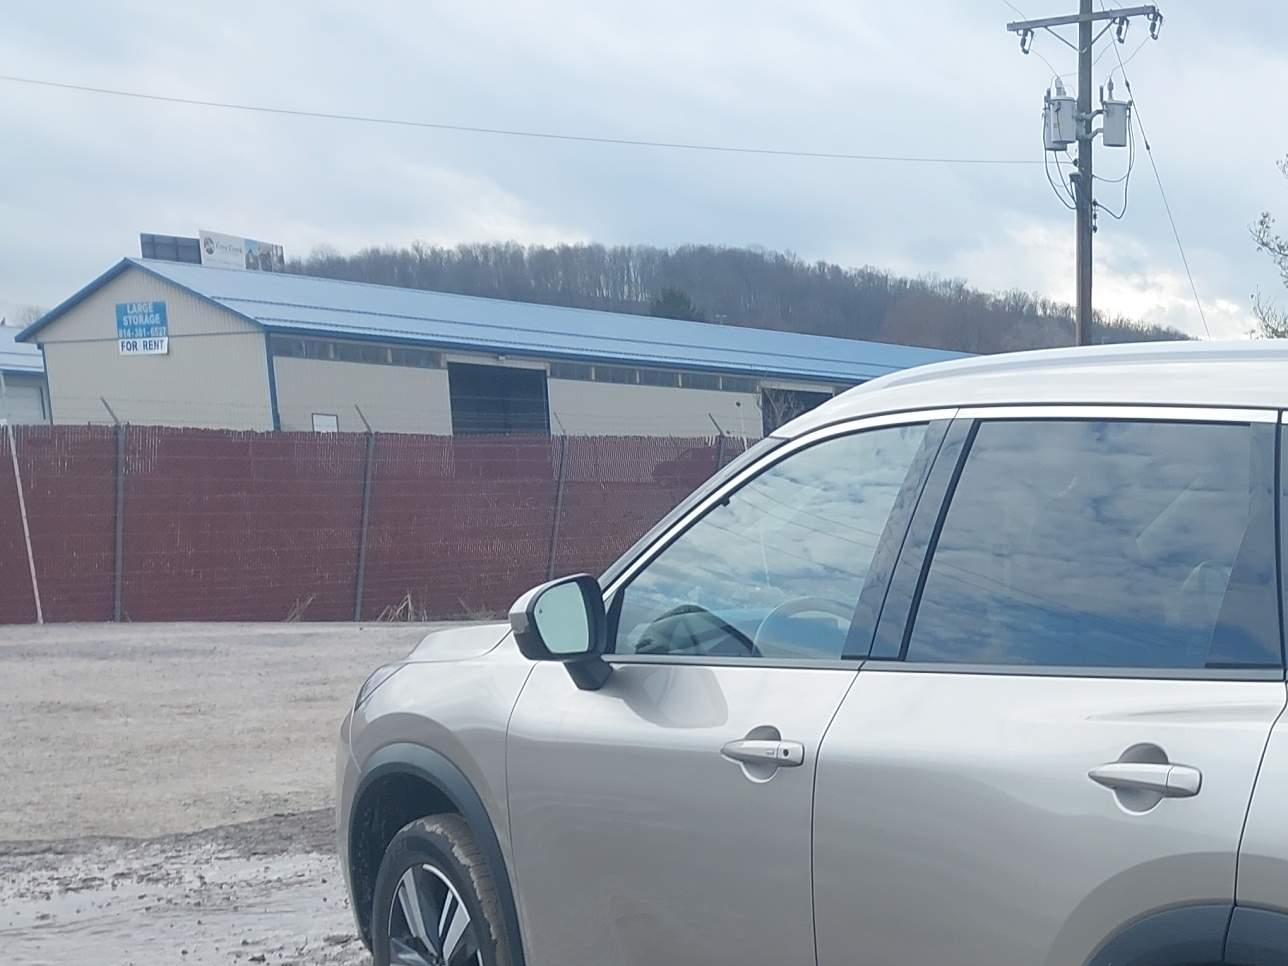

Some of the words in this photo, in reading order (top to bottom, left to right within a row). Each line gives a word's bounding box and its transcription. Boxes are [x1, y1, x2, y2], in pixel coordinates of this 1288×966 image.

[127, 303, 154, 314] LARGE
[123, 313, 161, 326] STORAGE
[121, 340, 138, 352] FOR
[142, 339, 165, 351] RENT
